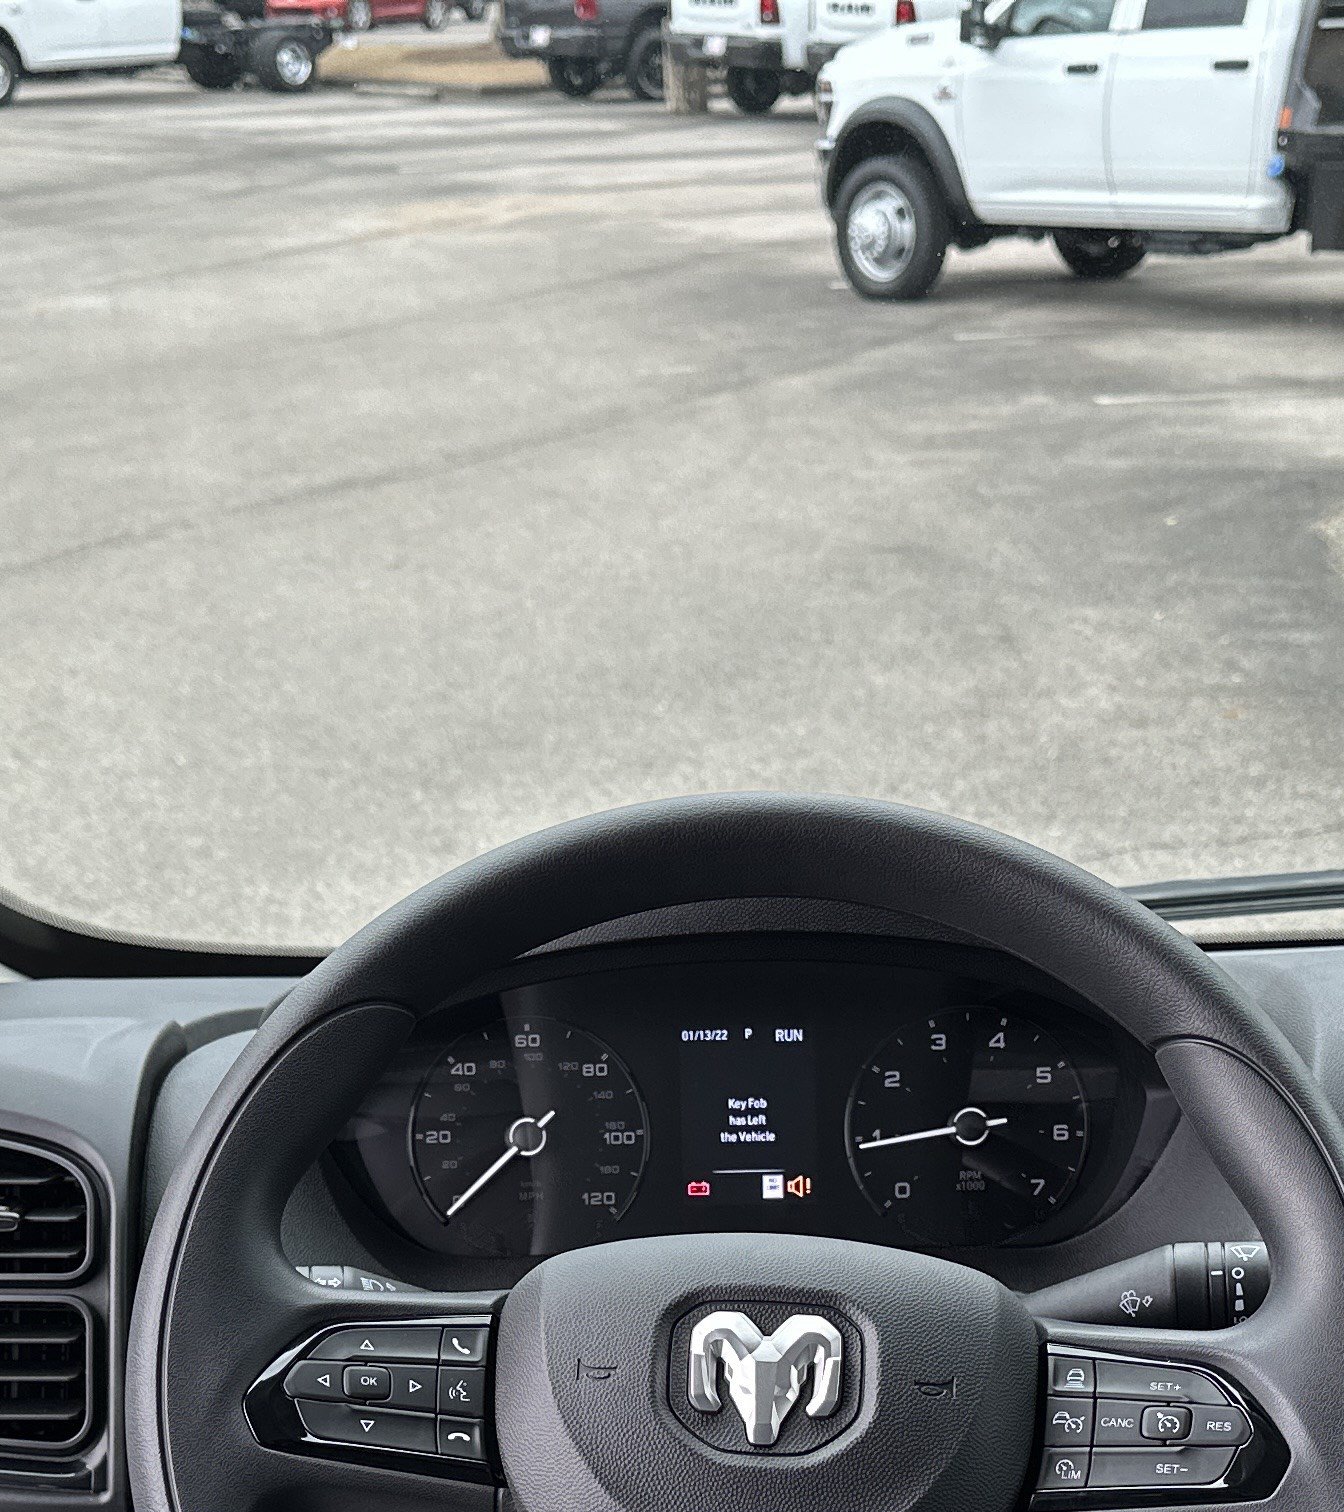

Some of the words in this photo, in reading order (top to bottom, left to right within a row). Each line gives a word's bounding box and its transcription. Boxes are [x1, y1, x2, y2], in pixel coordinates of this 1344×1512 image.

[514, 1033, 541, 1048] 60
[681, 1029, 728, 1042] 01/13/22
[744, 1028, 753, 1039] P
[775, 1028, 804, 1042] RUN
[930, 1033, 947, 1050] 3
[988, 1032, 1006, 1049] 4
[523, 1052, 544, 1062] 100
[450, 1062, 477, 1076] 40
[558, 1061, 579, 1071] 120
[582, 1063, 608, 1077] 80
[884, 1070, 901, 1088] 2
[1035, 1066, 1052, 1084] 5
[593, 1090, 614, 1099] 140
[728, 1098, 747, 1111] Key
[748, 1097, 767, 1109] Fob
[729, 1115, 746, 1125] has
[747, 1115, 767, 1126] Left
[425, 1130, 452, 1144] 20
[604, 1131, 636, 1145] 100
[720, 1132, 738, 1142] the
[739, 1130, 776, 1142] Vehicle
[1052, 1124, 1069, 1141] 6
[959, 1170, 982, 1180] RPM
[894, 1182, 911, 1199] 0
[1030, 1178, 1046, 1196] 7
[581, 1191, 616, 1206] 120
[360, 1376, 378, 1387] OK
[1150, 1381, 1182, 1391] SET+
[1101, 1417, 1134, 1428] CANC
[1206, 1421, 1232, 1432] RES
[1061, 1469, 1082, 1480] LIM
[1156, 1463, 1189, 1475] SET-
